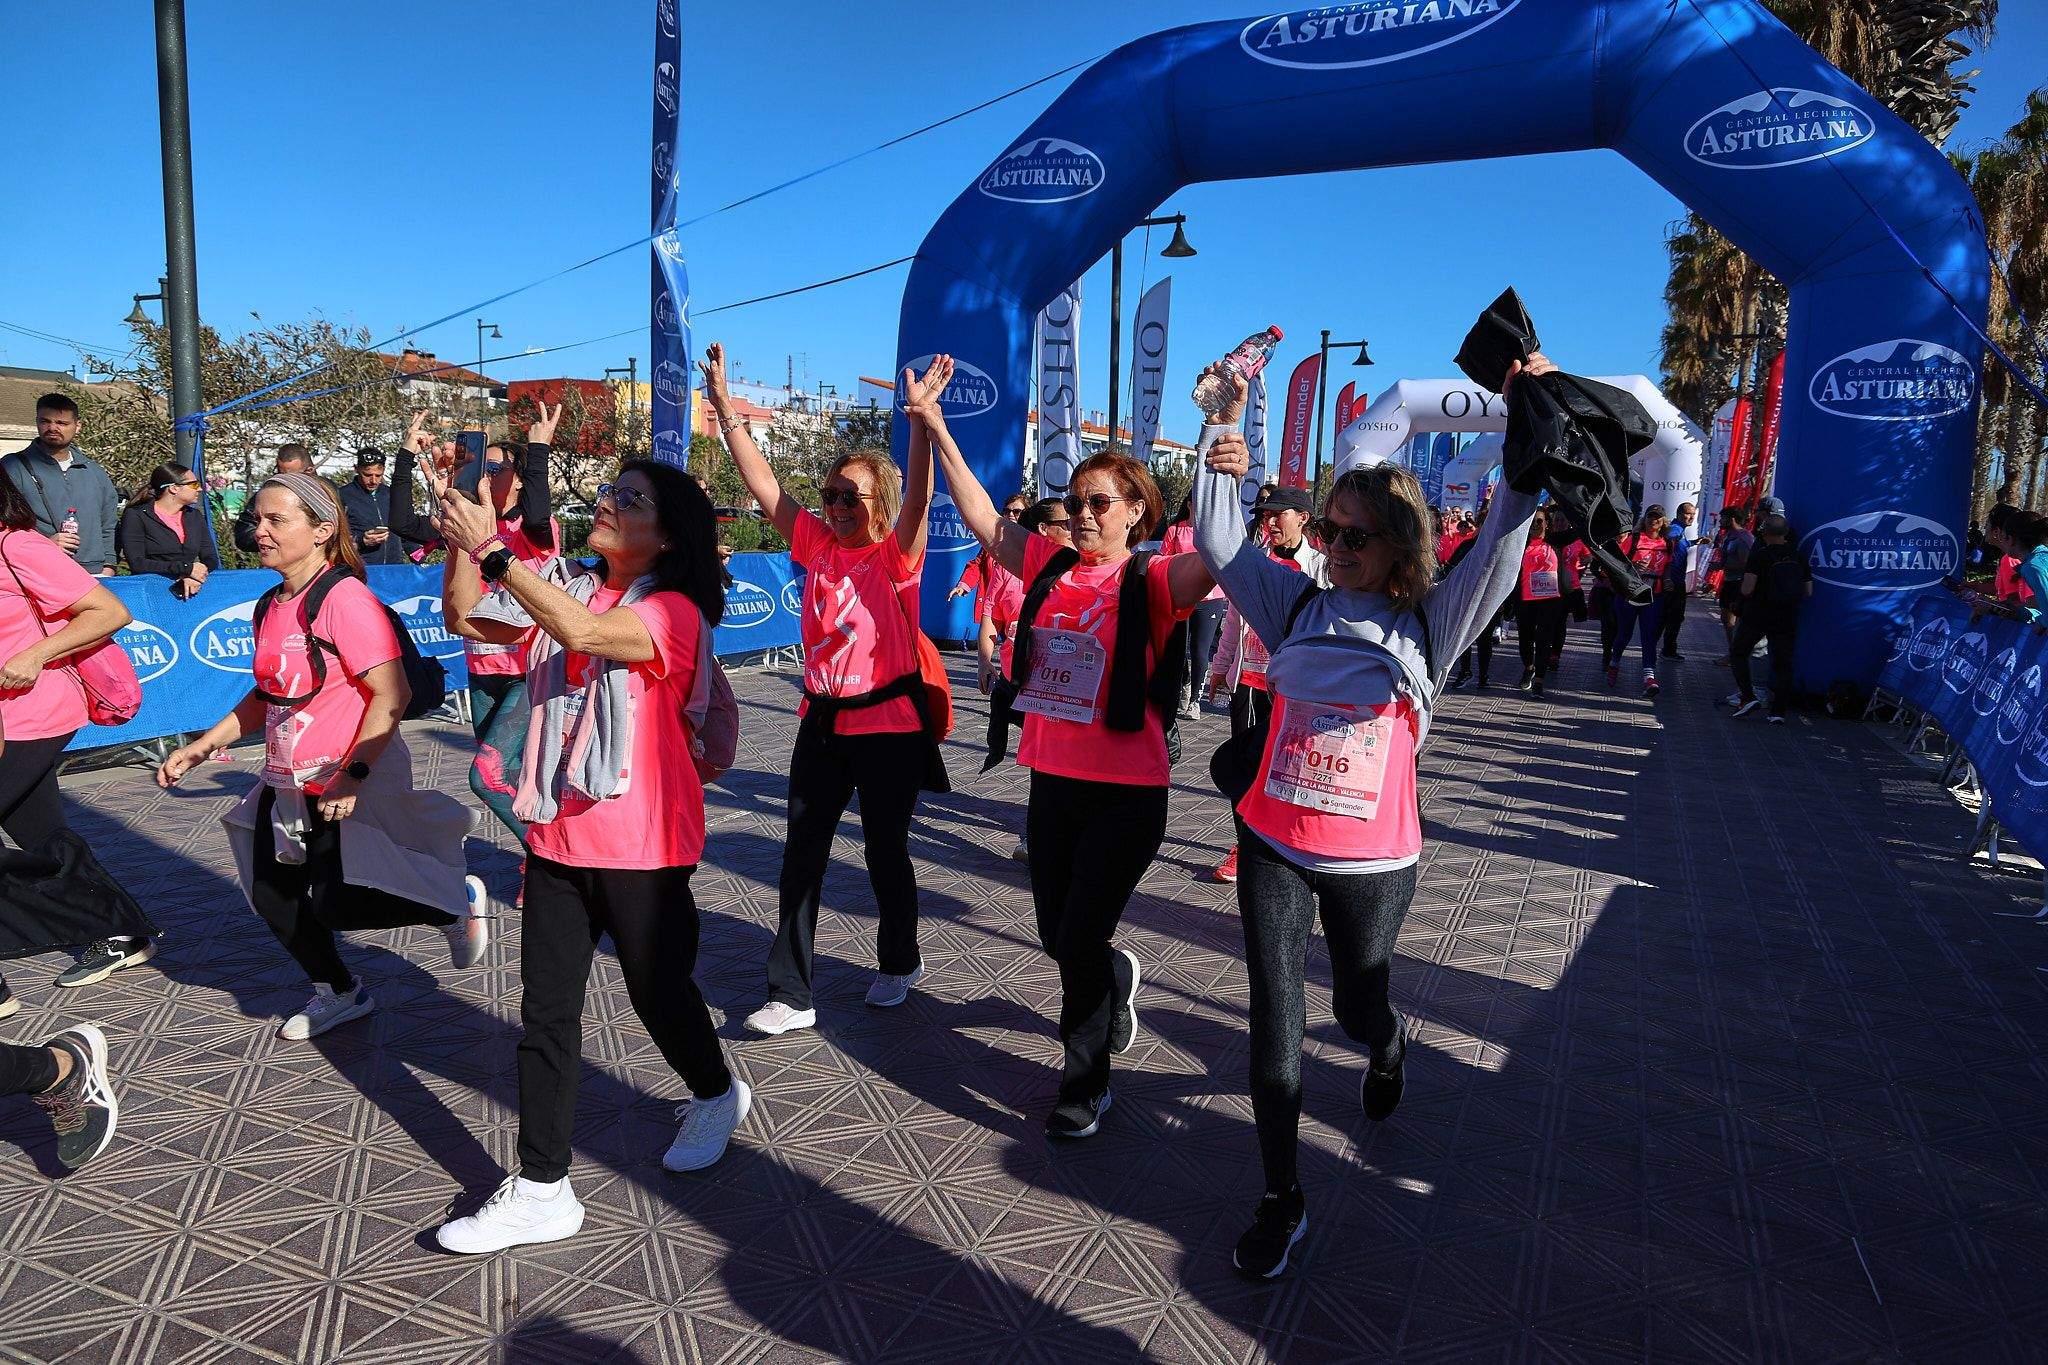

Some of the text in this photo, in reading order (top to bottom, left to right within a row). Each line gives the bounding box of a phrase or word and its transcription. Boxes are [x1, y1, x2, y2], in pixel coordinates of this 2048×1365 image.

[1257, 0, 1500, 49] ASTURIANA
[1726, 109, 1855, 129] CENTRAL LECHERA
[1697, 119, 1864, 156] ASTURIANA
[1005, 158, 1090, 169] CENTRAL LECHERA
[984, 166, 1095, 189] ASTURIANA
[1847, 366, 1909, 377] CENTRAL
[1819, 371, 1968, 402] ASTURIANA
[1291, 377, 1310, 453] Santander
[1358, 422, 1400, 432] OYSHO
[1652, 481, 1696, 491] OYSHO
[1833, 537, 1951, 547] CENTRAL LECHERA
[1808, 538, 1952, 570] ASTURIANA
[1041, 666, 1072, 684] 016
[1307, 750, 1350, 774] 016
[1312, 772, 1332, 783] 7271
[1317, 784, 1336, 793] MUJER
[1340, 789, 1365, 799] VALENCIA
[1329, 800, 1364, 811] Santander
